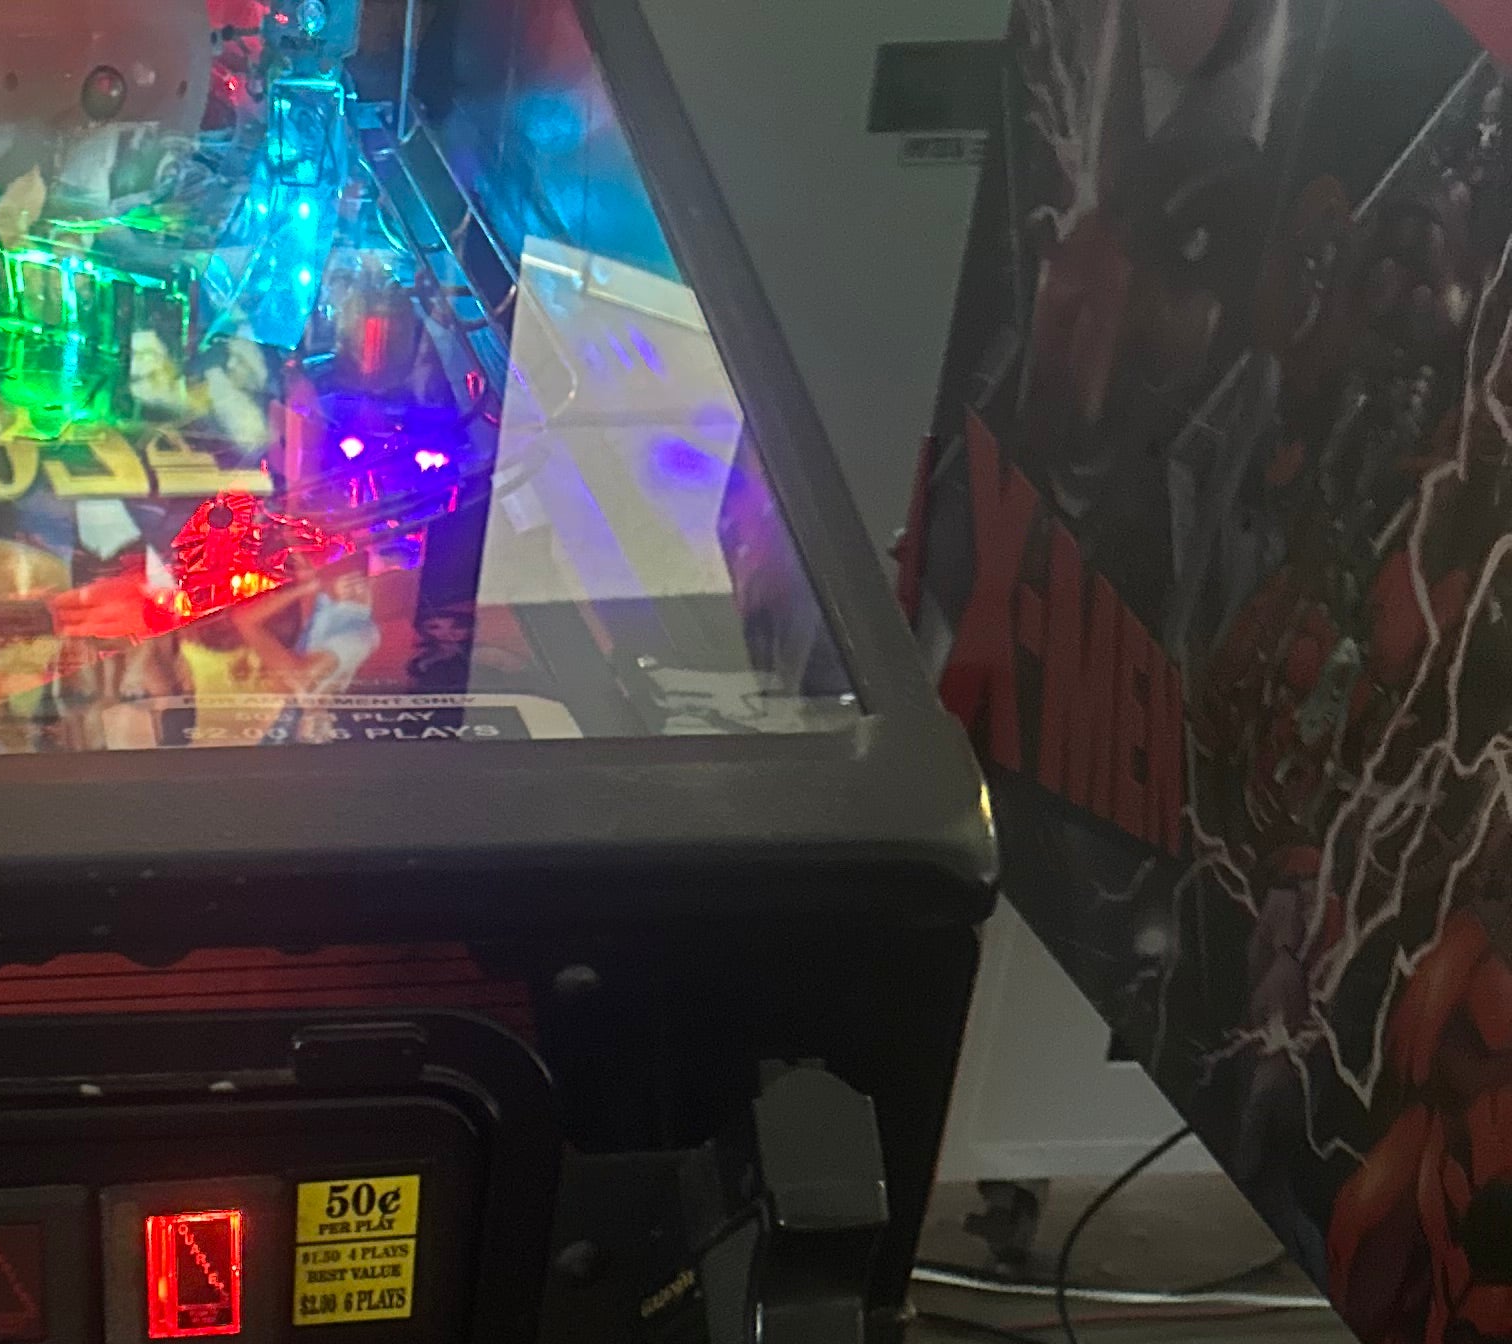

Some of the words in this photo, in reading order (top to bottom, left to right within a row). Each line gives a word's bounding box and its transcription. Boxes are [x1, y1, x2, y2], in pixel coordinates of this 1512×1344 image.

[940, 404, 1182, 858] X-MEN
[352, 712, 435, 722] PLAY
[364, 724, 501, 740] PLAYS
[325, 1182, 402, 1219] 50¢
[319, 1221, 351, 1235] PER
[354, 1217, 395, 1233] PLAY
[361, 1244, 409, 1260] PLAYS
[306, 1269, 347, 1283] BEST
[350, 1264, 401, 1280] VALUE
[357, 1288, 406, 1311] PLAYS
